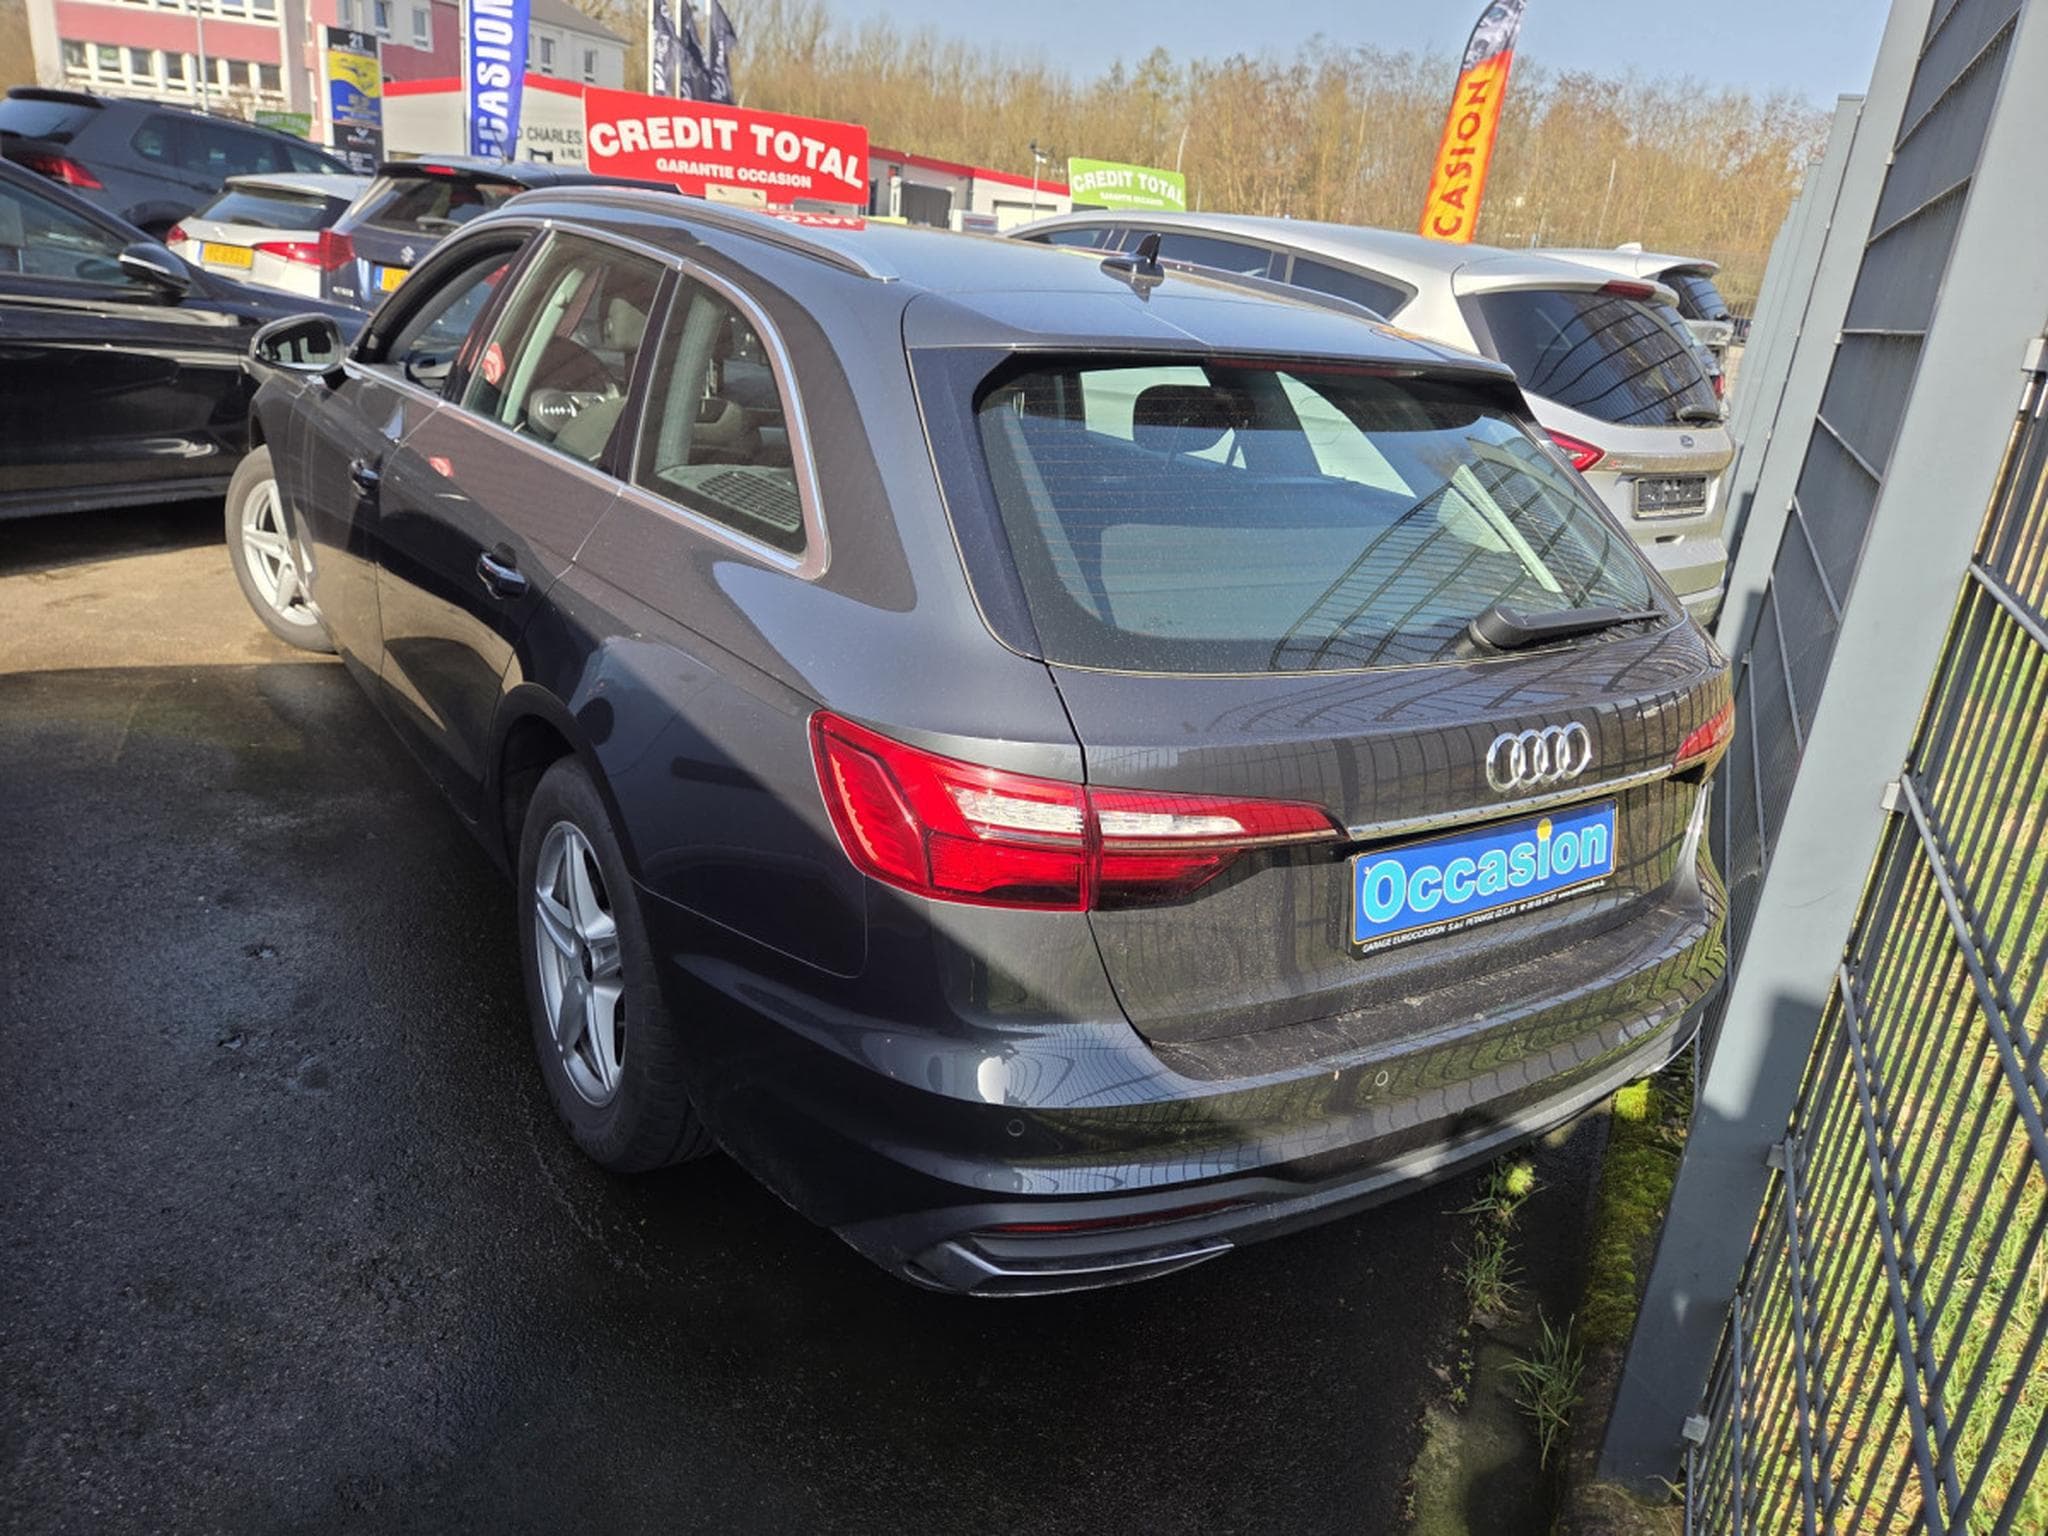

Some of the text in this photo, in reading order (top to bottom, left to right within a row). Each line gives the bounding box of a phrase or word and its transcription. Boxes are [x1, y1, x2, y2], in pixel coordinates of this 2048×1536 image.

[348, 32, 364, 49] 21
[526, 126, 583, 145] CHARLES
[588, 116, 864, 189] CREDIT TOTAL
[655, 157, 812, 189] GARANTIE OCCASION
[1432, 79, 1490, 237] CASION
[1072, 169, 1134, 193] CREDIT
[1136, 173, 1184, 207] TOTAL
[1362, 817, 1608, 924] Occasion
[1361, 938, 1392, 953] GARAGE
